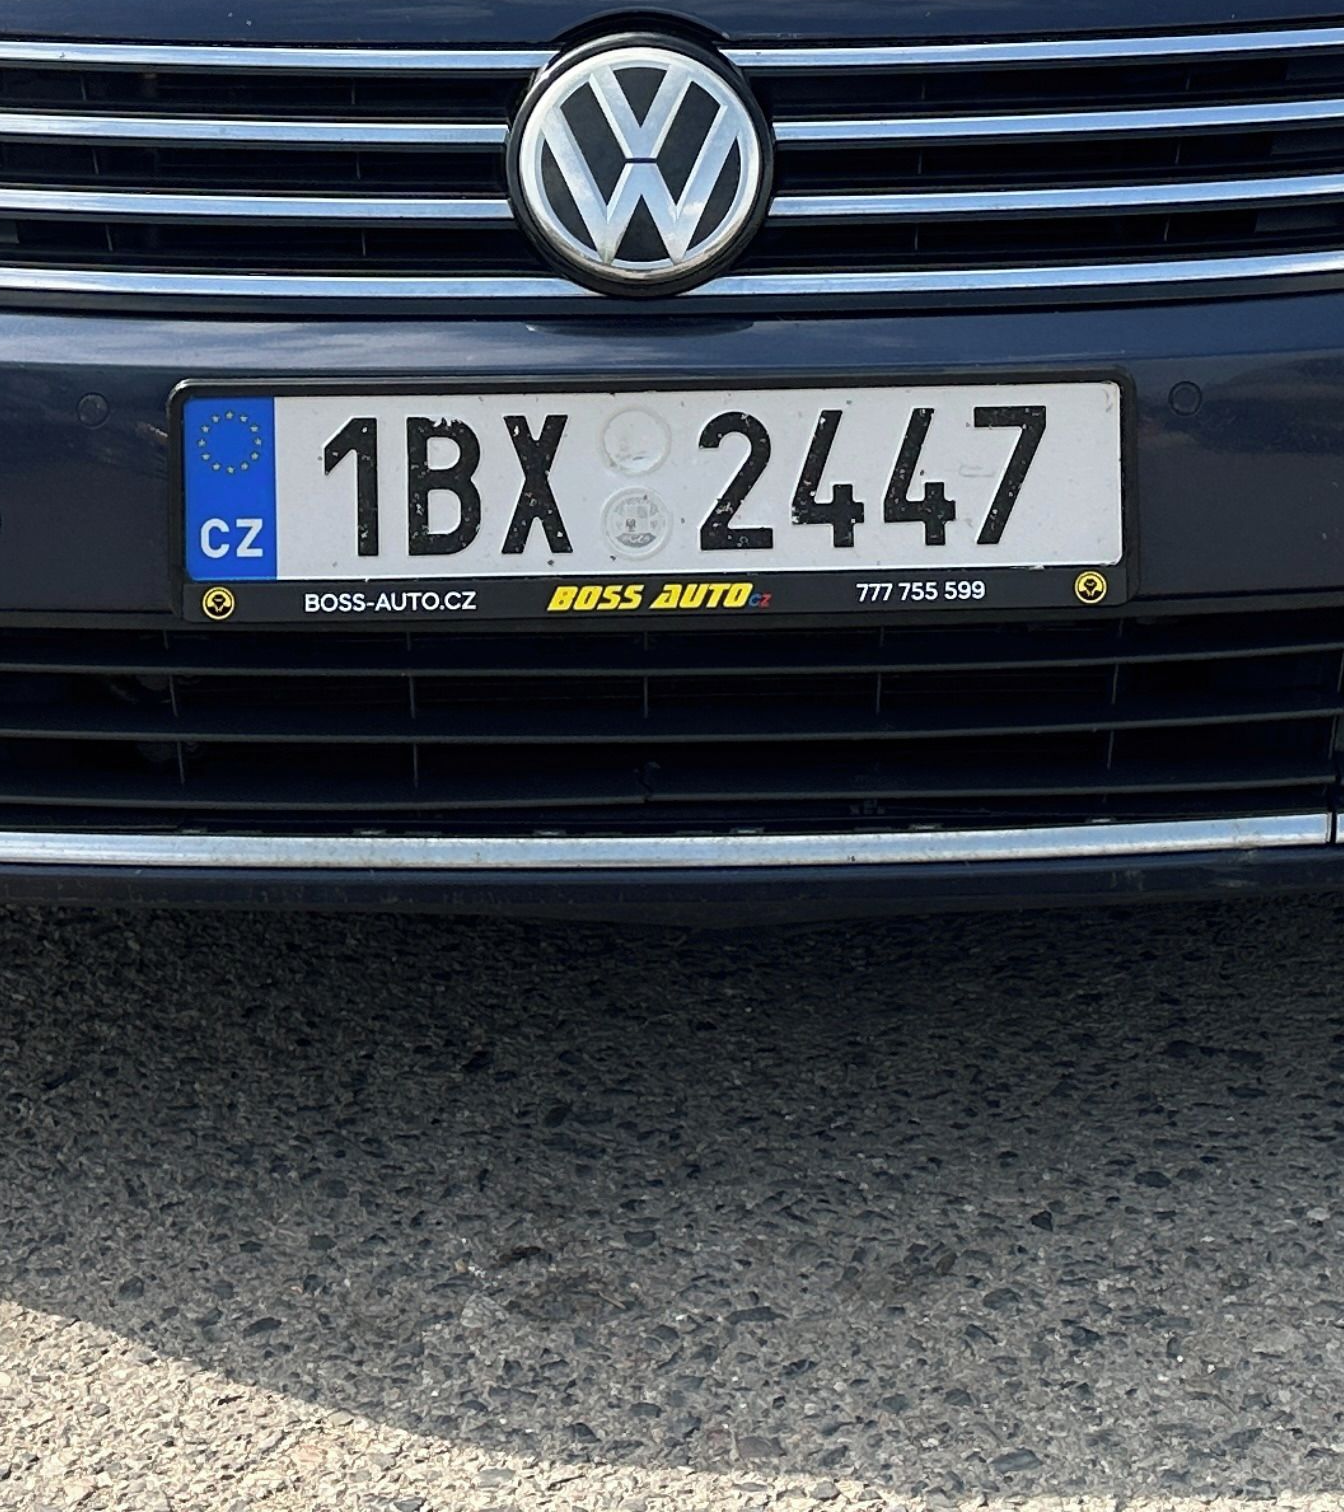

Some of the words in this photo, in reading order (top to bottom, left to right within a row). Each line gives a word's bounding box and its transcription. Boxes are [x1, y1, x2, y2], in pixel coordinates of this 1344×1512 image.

[528, 54, 750, 272] VW
[322, 413, 572, 556] 1BX
[697, 405, 1047, 551] 2447
[200, 518, 263, 558] CZ
[305, 591, 476, 613] BOSS-AUTO.CZ
[547, 585, 644, 611] BOSS
[649, 583, 753, 609] AUTO
[856, 583, 893, 602] 777
[898, 582, 938, 601] 755
[944, 581, 985, 600] 599
